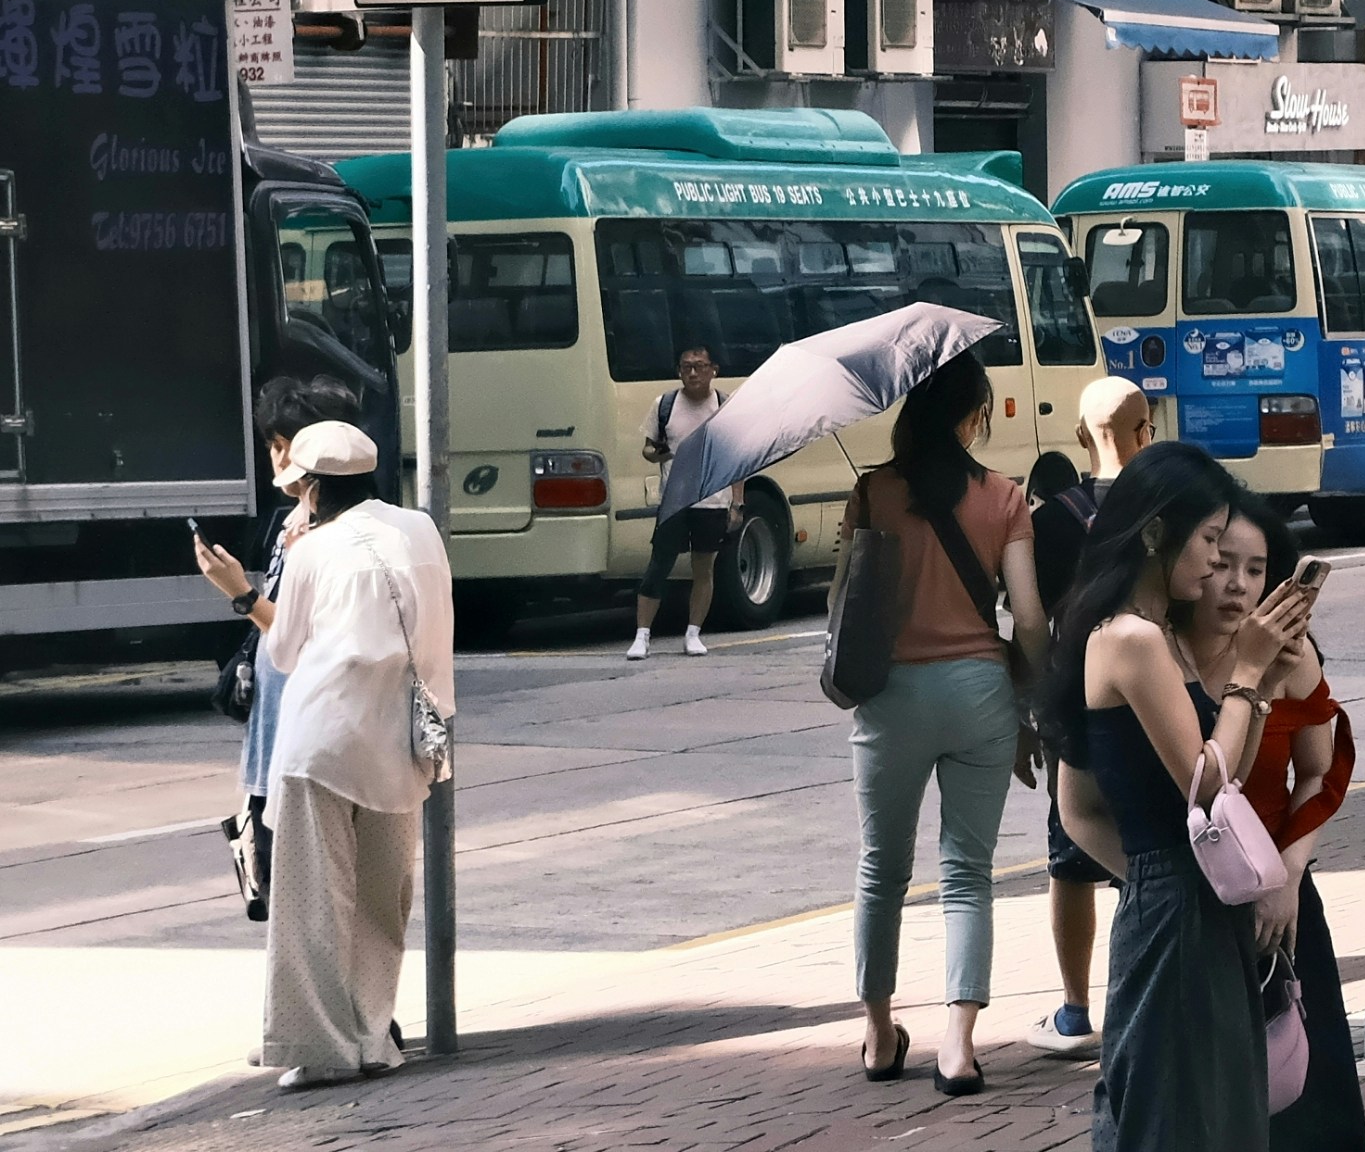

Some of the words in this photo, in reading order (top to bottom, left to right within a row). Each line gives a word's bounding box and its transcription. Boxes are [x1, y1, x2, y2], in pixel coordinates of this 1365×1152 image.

[1270, 75, 1311, 120] Slow
[1310, 88, 1350, 133] House
[90, 132, 181, 181] Glorious
[673, 181, 715, 202] PUBLIC
[714, 182, 748, 204] LIGHT
[750, 183, 772, 205] BUS
[772, 185, 787, 205] 19
[787, 184, 823, 206] SEATS
[1103, 181, 1160, 200] AMS
[1329, 182, 1358, 199] PUBLIC
[1109, 350, 1135, 370] No.1
